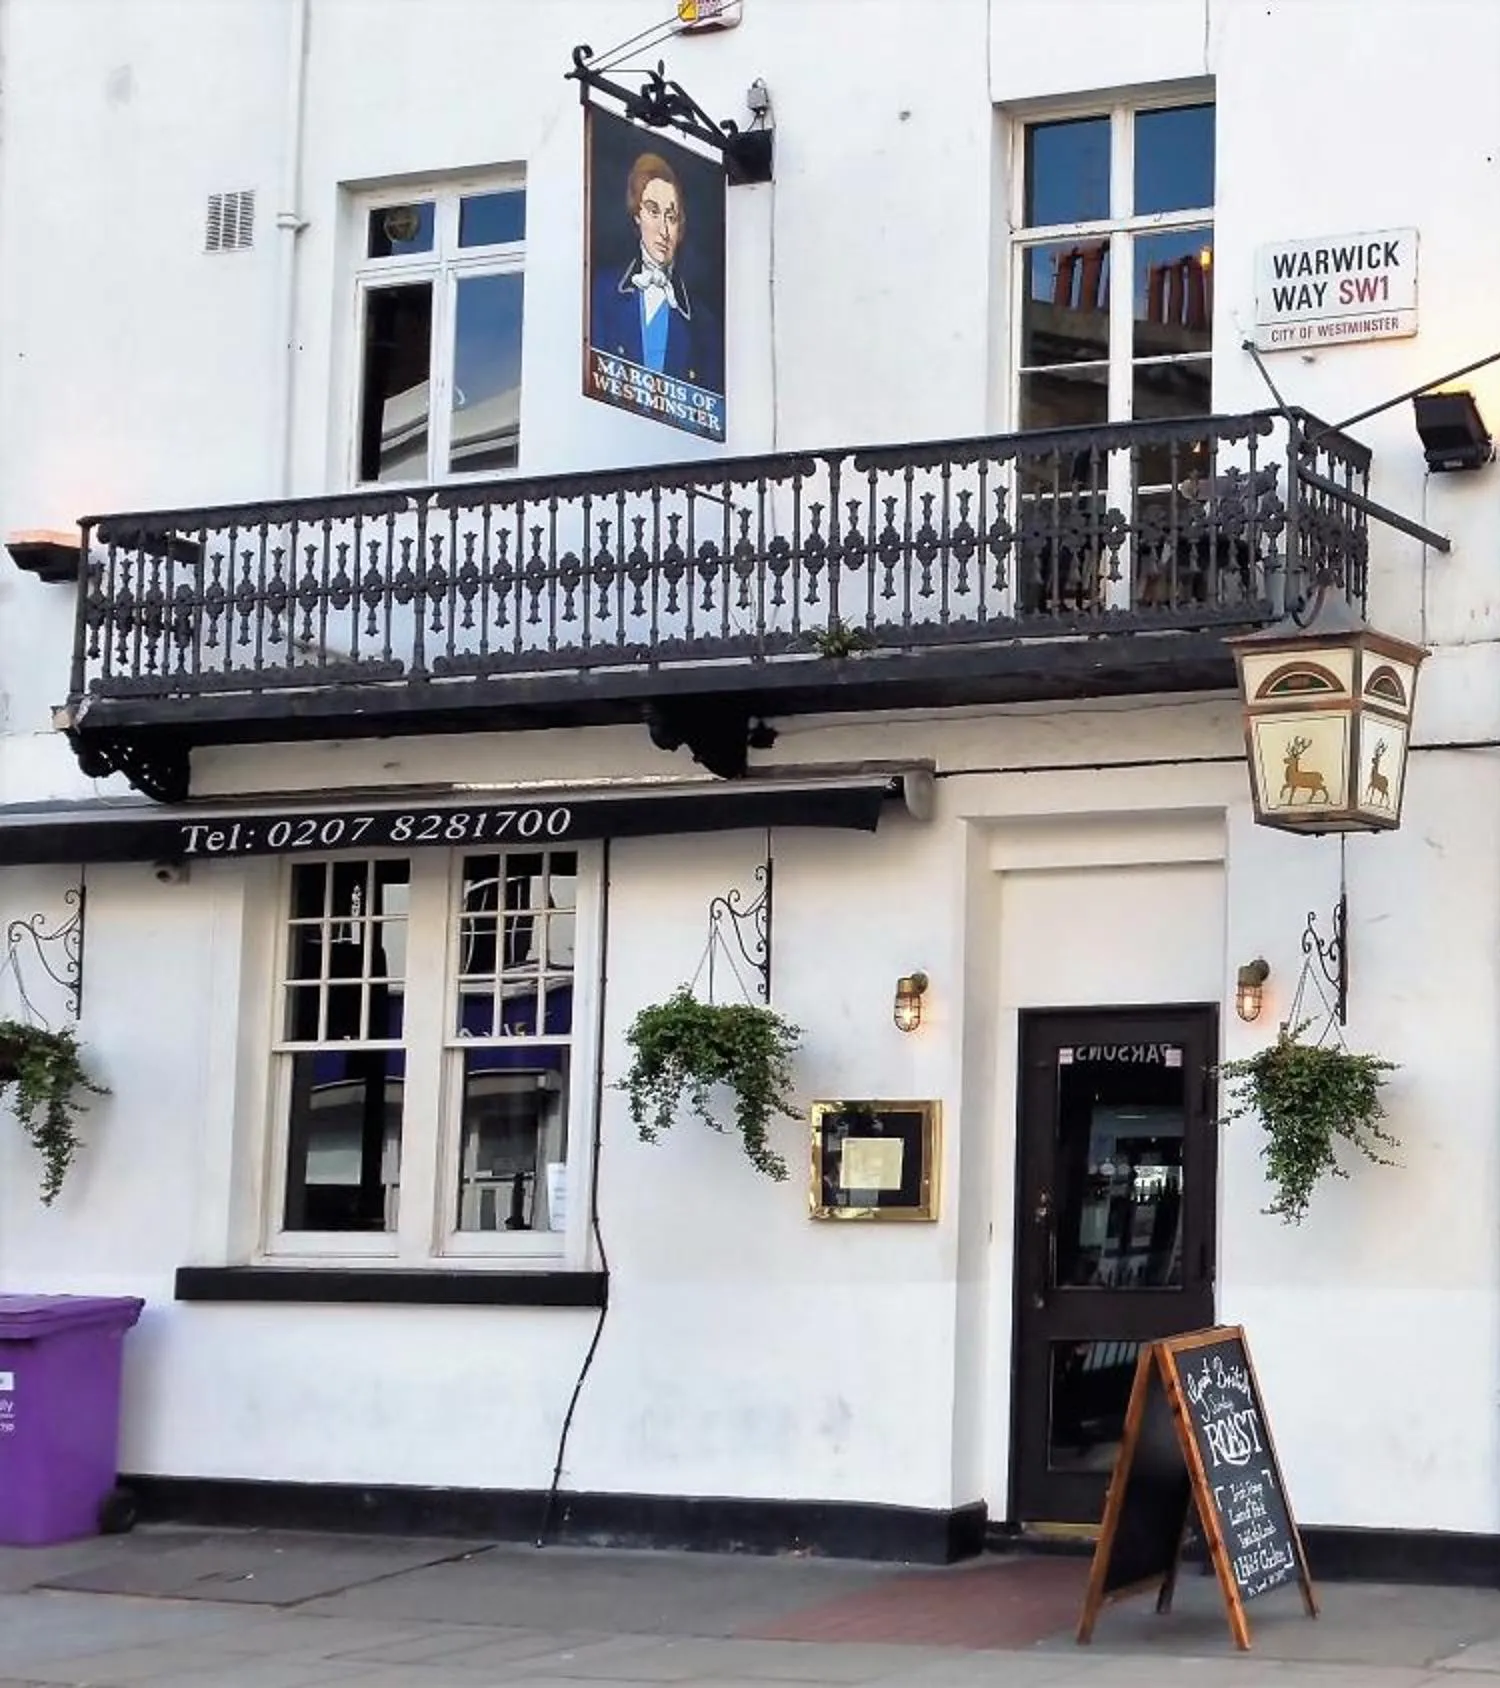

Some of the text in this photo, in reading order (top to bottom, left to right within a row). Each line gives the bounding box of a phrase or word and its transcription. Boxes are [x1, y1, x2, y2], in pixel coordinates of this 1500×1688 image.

[1273, 240, 1400, 279] WARWICK
[1272, 275, 1389, 312] WAY SW1
[1271, 317, 1400, 343] CITY OF WESTMINSTER
[593, 371, 721, 431] WESTMINSTER
[597, 356, 717, 410] MARQUIS OF
[181, 807, 572, 854] Tel: 0207 8281700
[1203, 1409, 1262, 1466] ROAST
